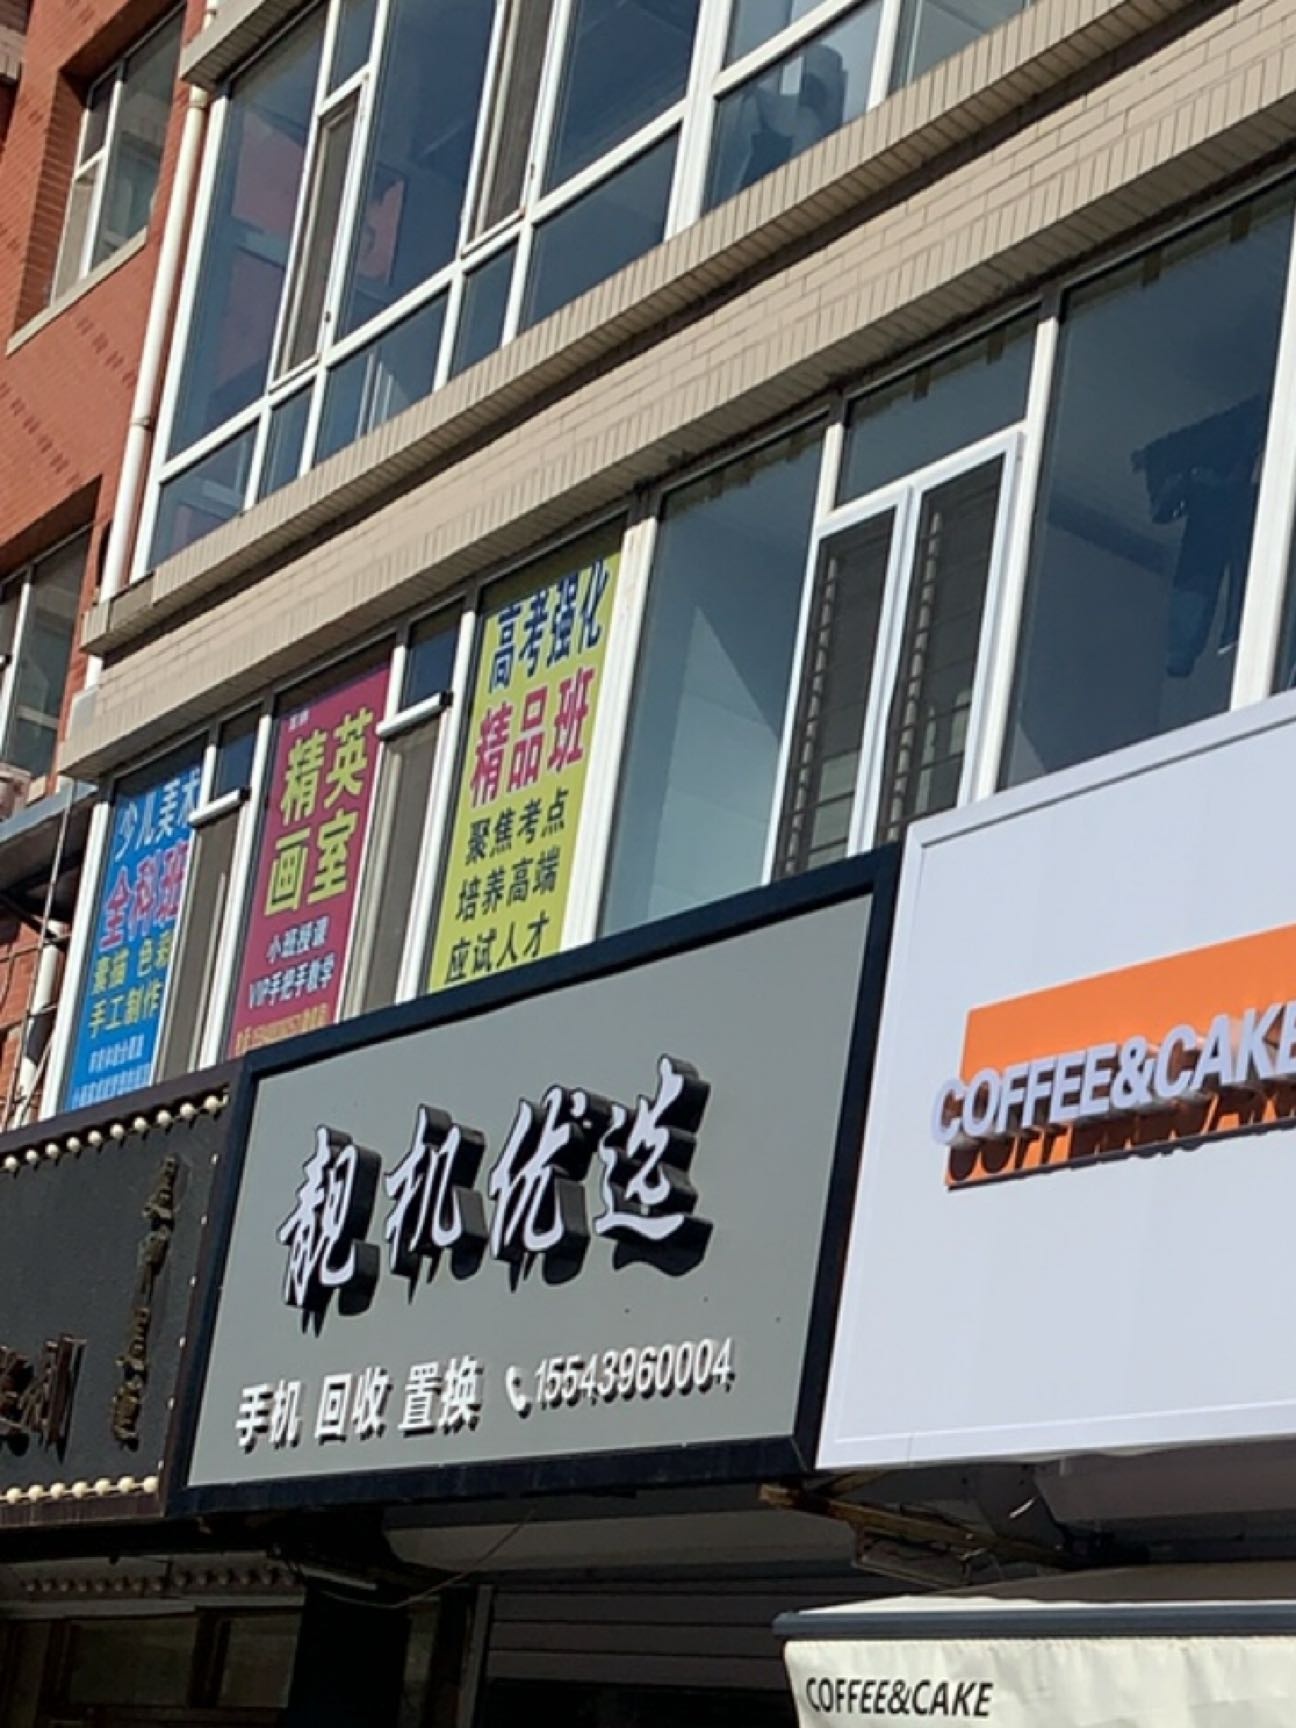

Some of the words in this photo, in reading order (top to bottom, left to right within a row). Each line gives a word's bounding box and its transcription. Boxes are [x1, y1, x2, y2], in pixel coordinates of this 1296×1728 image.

[490, 560, 609, 694] 高考强化
[281, 706, 374, 826] 精英
[470, 667, 595, 808] 精品班
[264, 808, 360, 916] 画室
[465, 787, 568, 866] 聚焦考点
[455, 846, 561, 922] 培养高端
[444, 909, 550, 984] 应试人才
[235, 1380, 302, 1450] 手机
[314, 1366, 393, 1442] 回收
[398, 1353, 484, 1435] 置换
[535, 1337, 736, 1405] 15543960004
[806, 1676, 994, 1717] COFFEE&CAKE
